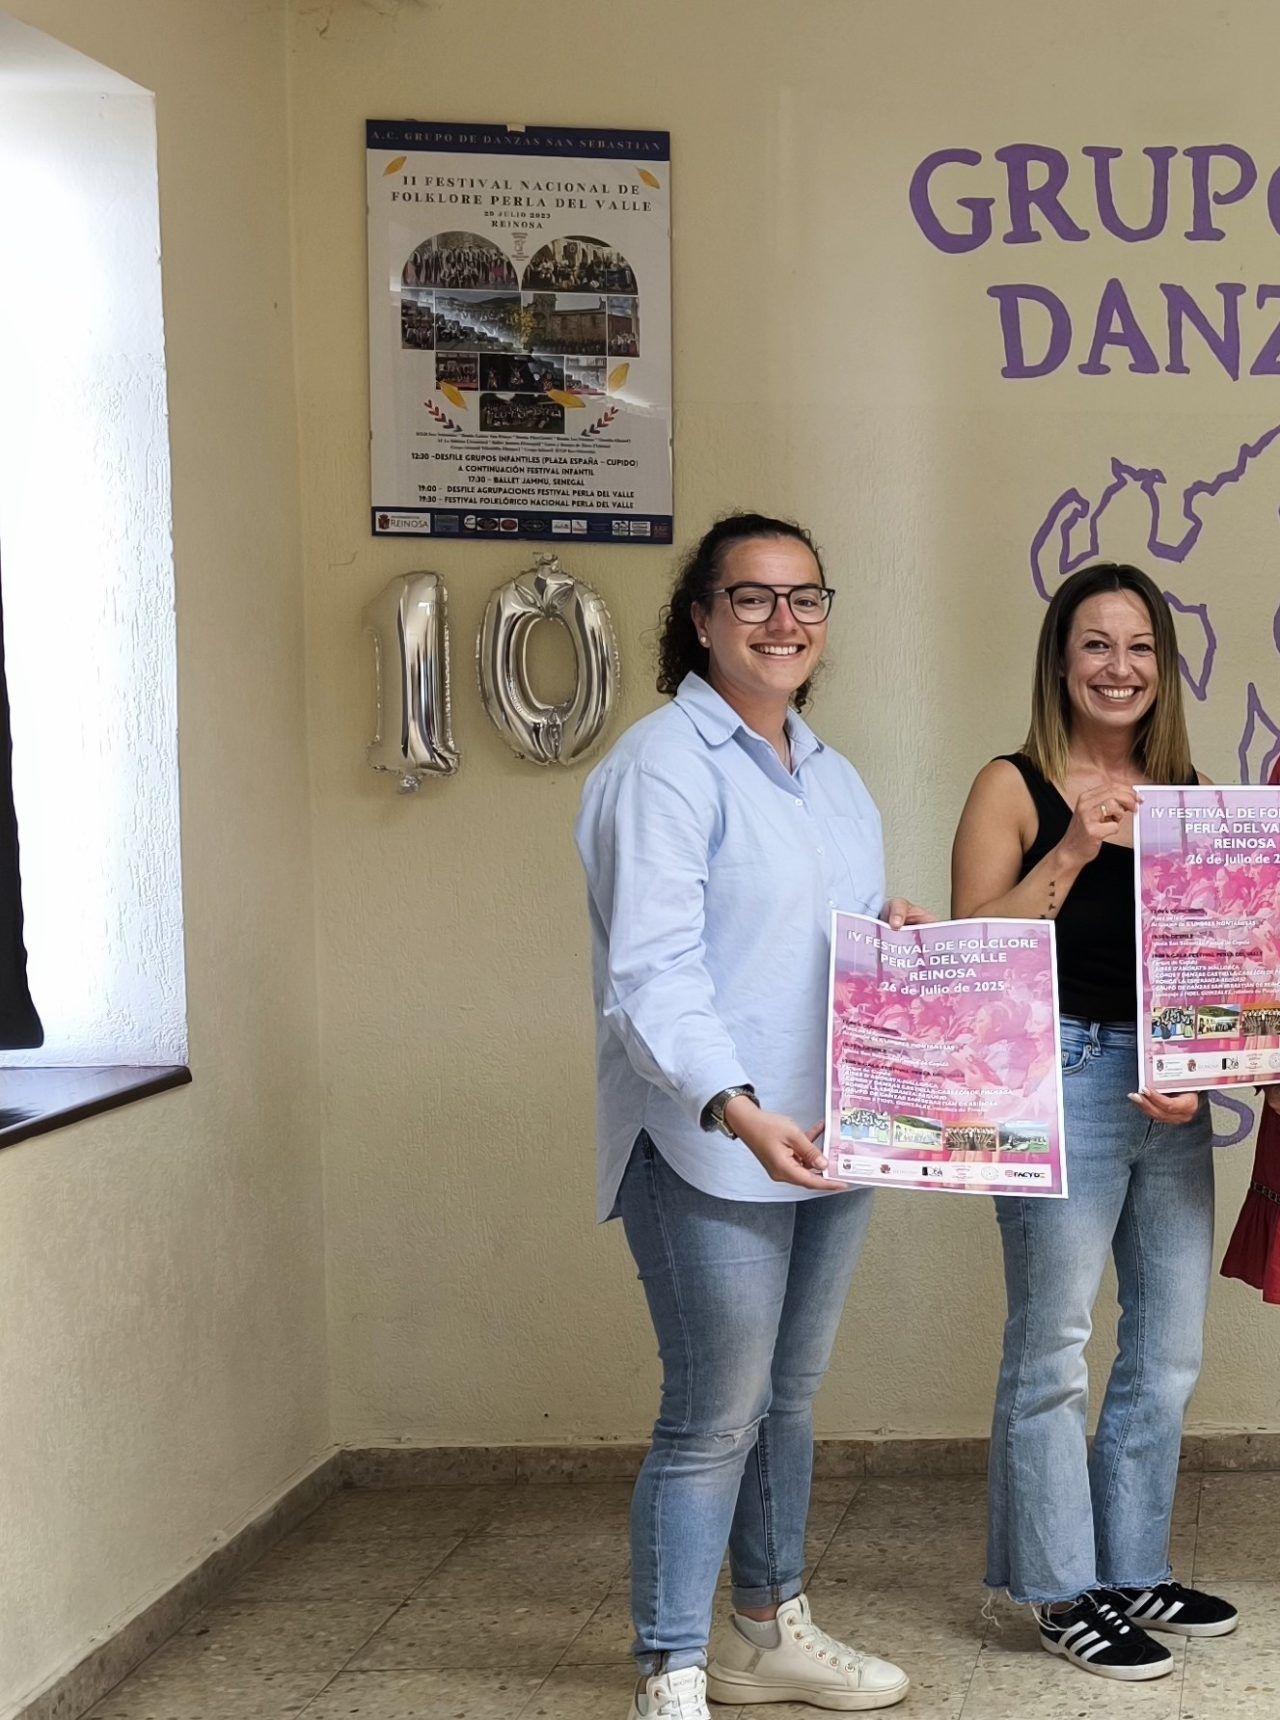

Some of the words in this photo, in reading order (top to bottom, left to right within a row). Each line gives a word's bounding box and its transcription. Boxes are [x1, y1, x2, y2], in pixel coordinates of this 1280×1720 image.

[403, 176, 416, 186] II
[425, 177, 512, 190] FESTIVAL
[520, 181, 610, 194] NACIONAL
[619, 185, 640, 195] DE
[391, 191, 483, 205] FOLKLORE
[490, 195, 546, 208] PERLA
[556, 198, 587, 209] DEL
[596, 200, 652, 211] VALLE
[491, 220, 543, 229] REINOSA
[465, 454, 496, 462] GRUPOS
[499, 454, 540, 464] INFANTILES
[569, 456, 598, 465] ESPAÑA
[465, 464, 525, 474] CONTINUACIÓN
[561, 468, 594, 476] INFANTIL
[493, 476, 519, 484] BALLET
[553, 478, 585, 486] SENEGAL
[477, 486, 535, 495] AGRUPACIONES
[537, 488, 570, 496] FESTIVAL
[597, 490, 610, 498] DEL
[444, 496, 477, 504] FESTIVAL
[530, 498, 569, 507] NACIONAL
[571, 500, 594, 508] PERLA
[596, 500, 610, 508] DEL
[612, 501, 634, 509] VALLE
[390, 519, 428, 528] REINOSA
[1151, 807, 1165, 818] IV
[1168, 807, 1233, 819] FESTIVAL
[1237, 807, 1255, 819] DE
[1184, 822, 1229, 834] PERLA
[1233, 822, 1260, 834] DEL
[1214, 838, 1277, 849] REINOSA
[1188, 854, 1203, 865] 26
[1206, 854, 1222, 865] de
[1224, 854, 1252, 866] Julio
[1255, 854, 1270, 864] de
[848, 931, 862, 942] IV
[865, 934, 930, 955] FESTIVAL
[935, 941, 954, 952] DE
[959, 938, 1039, 950] FOLCLORE
[880, 954, 926, 969] PERLA
[929, 954, 959, 966] DEL
[960, 952, 1007, 964] VALLE
[909, 967, 977, 981] REINOSA
[882, 981, 897, 993] 26
[900, 982, 917, 995] de
[920, 983, 950, 997] Julio
[953, 982, 970, 993] de
[974, 980, 1005, 992] 2025
